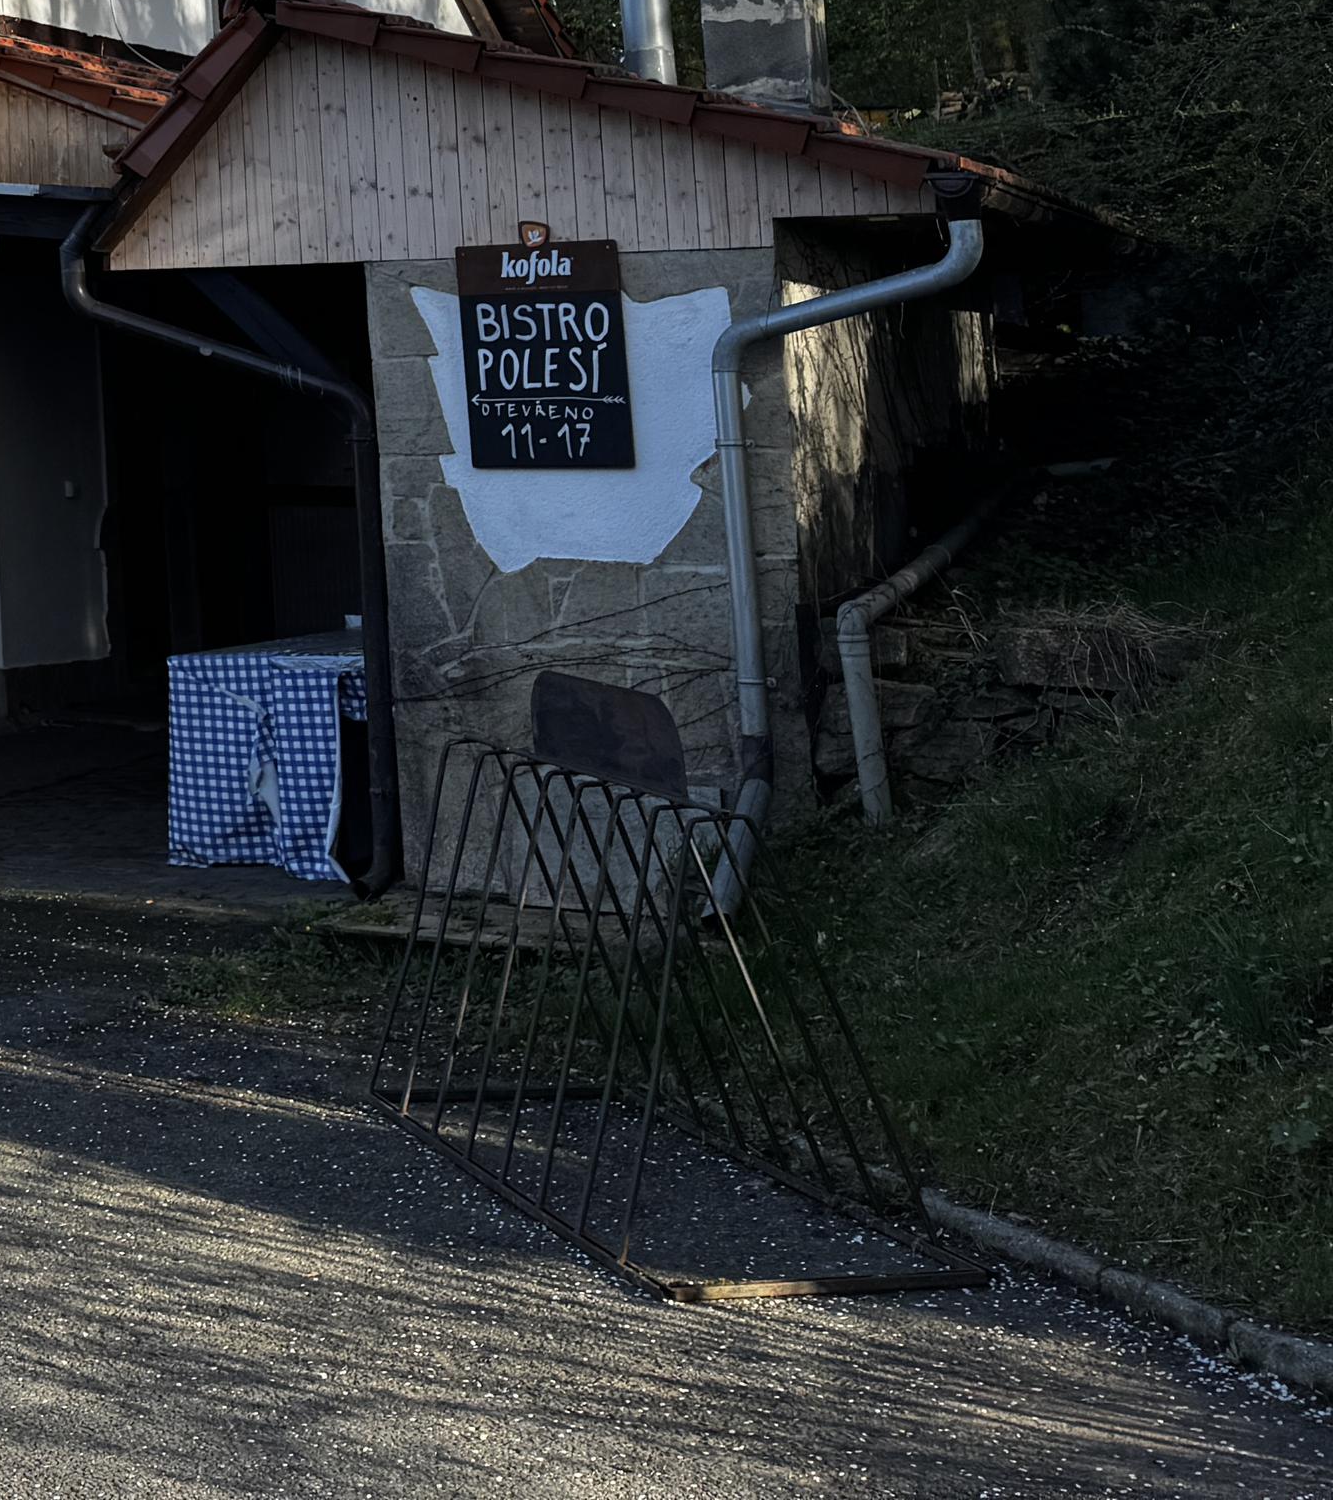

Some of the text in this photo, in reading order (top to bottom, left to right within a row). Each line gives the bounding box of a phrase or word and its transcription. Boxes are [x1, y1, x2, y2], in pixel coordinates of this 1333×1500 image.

[501, 250, 572, 285] kofola
[476, 302, 610, 342] BISTRO
[477, 342, 608, 393] POLESÍ
[482, 400, 594, 420] OTEVŘENO
